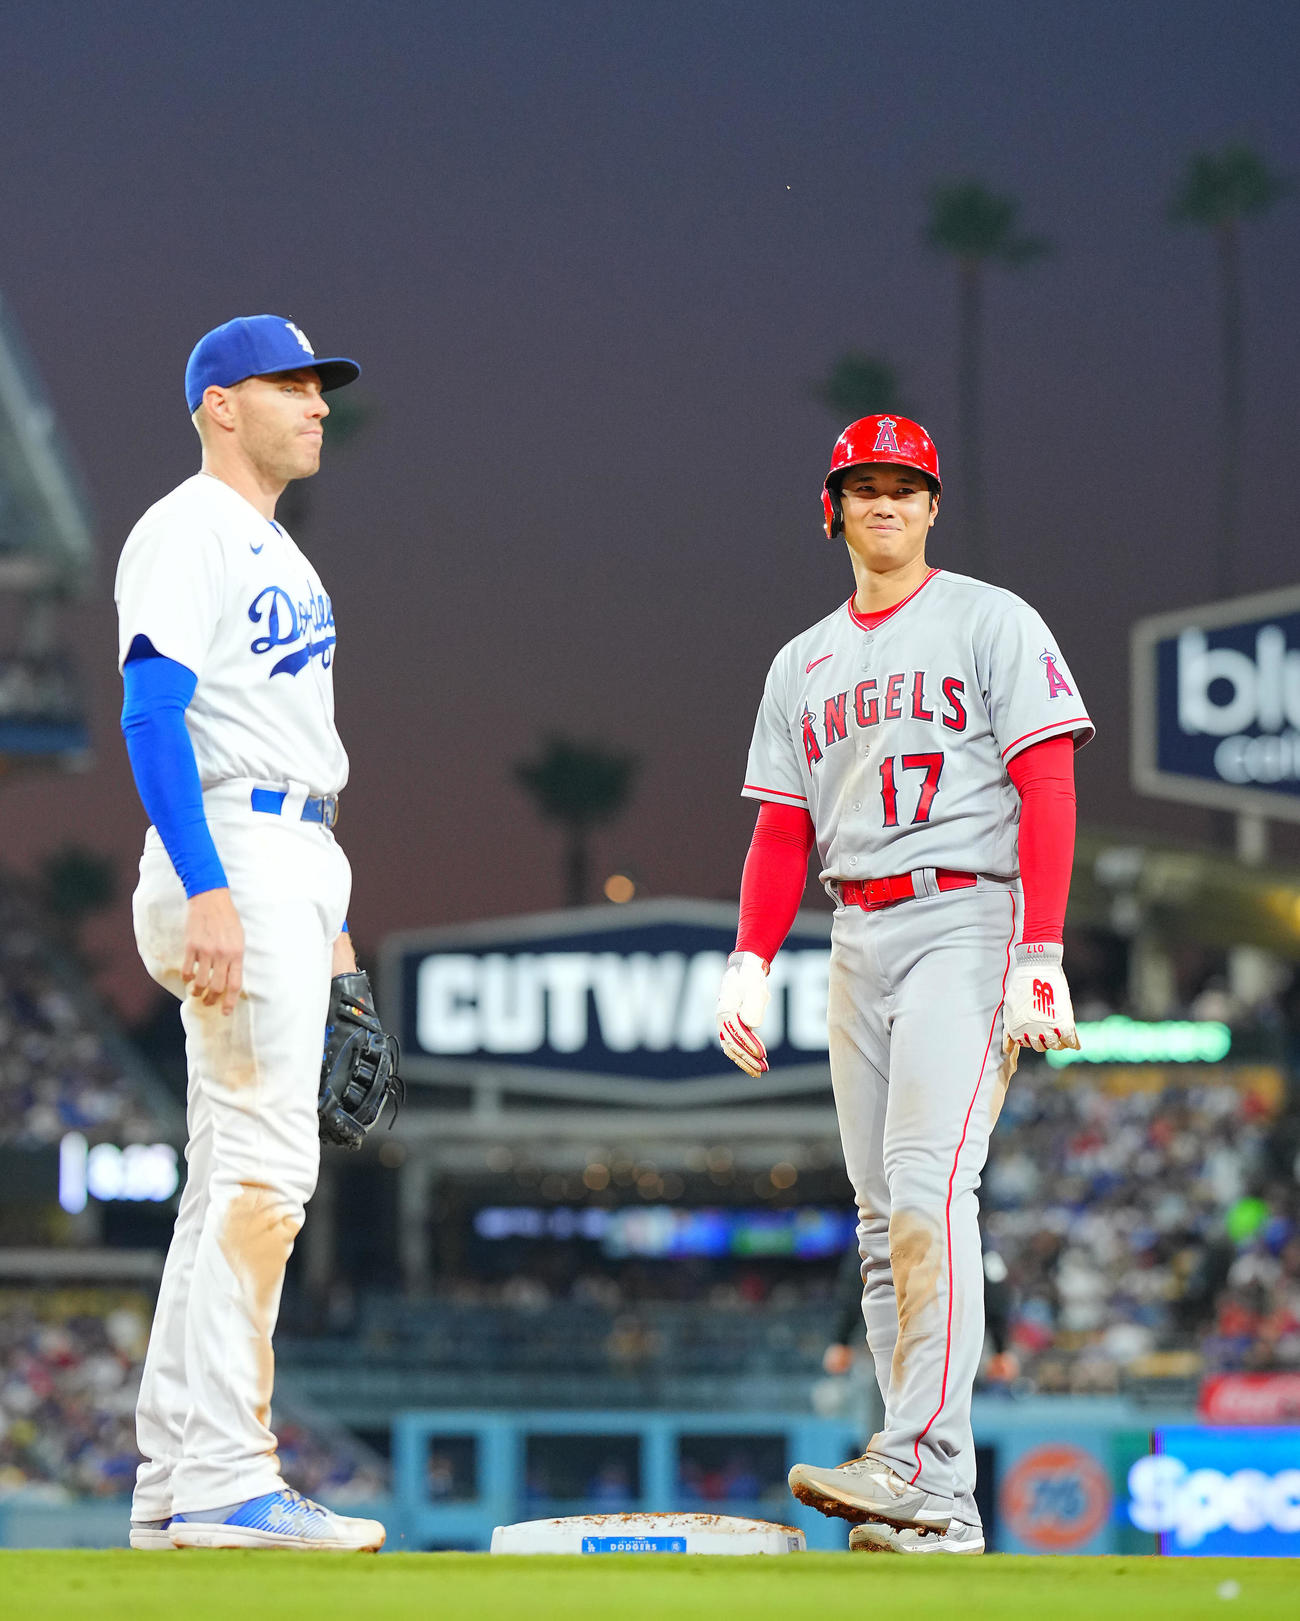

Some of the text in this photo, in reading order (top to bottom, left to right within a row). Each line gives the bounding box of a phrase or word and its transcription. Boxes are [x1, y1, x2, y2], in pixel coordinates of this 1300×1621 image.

[873, 417, 900, 452] A
[1039, 648, 1073, 699] A
[799, 670, 968, 777] ANGELS
[879, 751, 945, 828] 17
[610, 1543, 657, 1551] DODGERS
